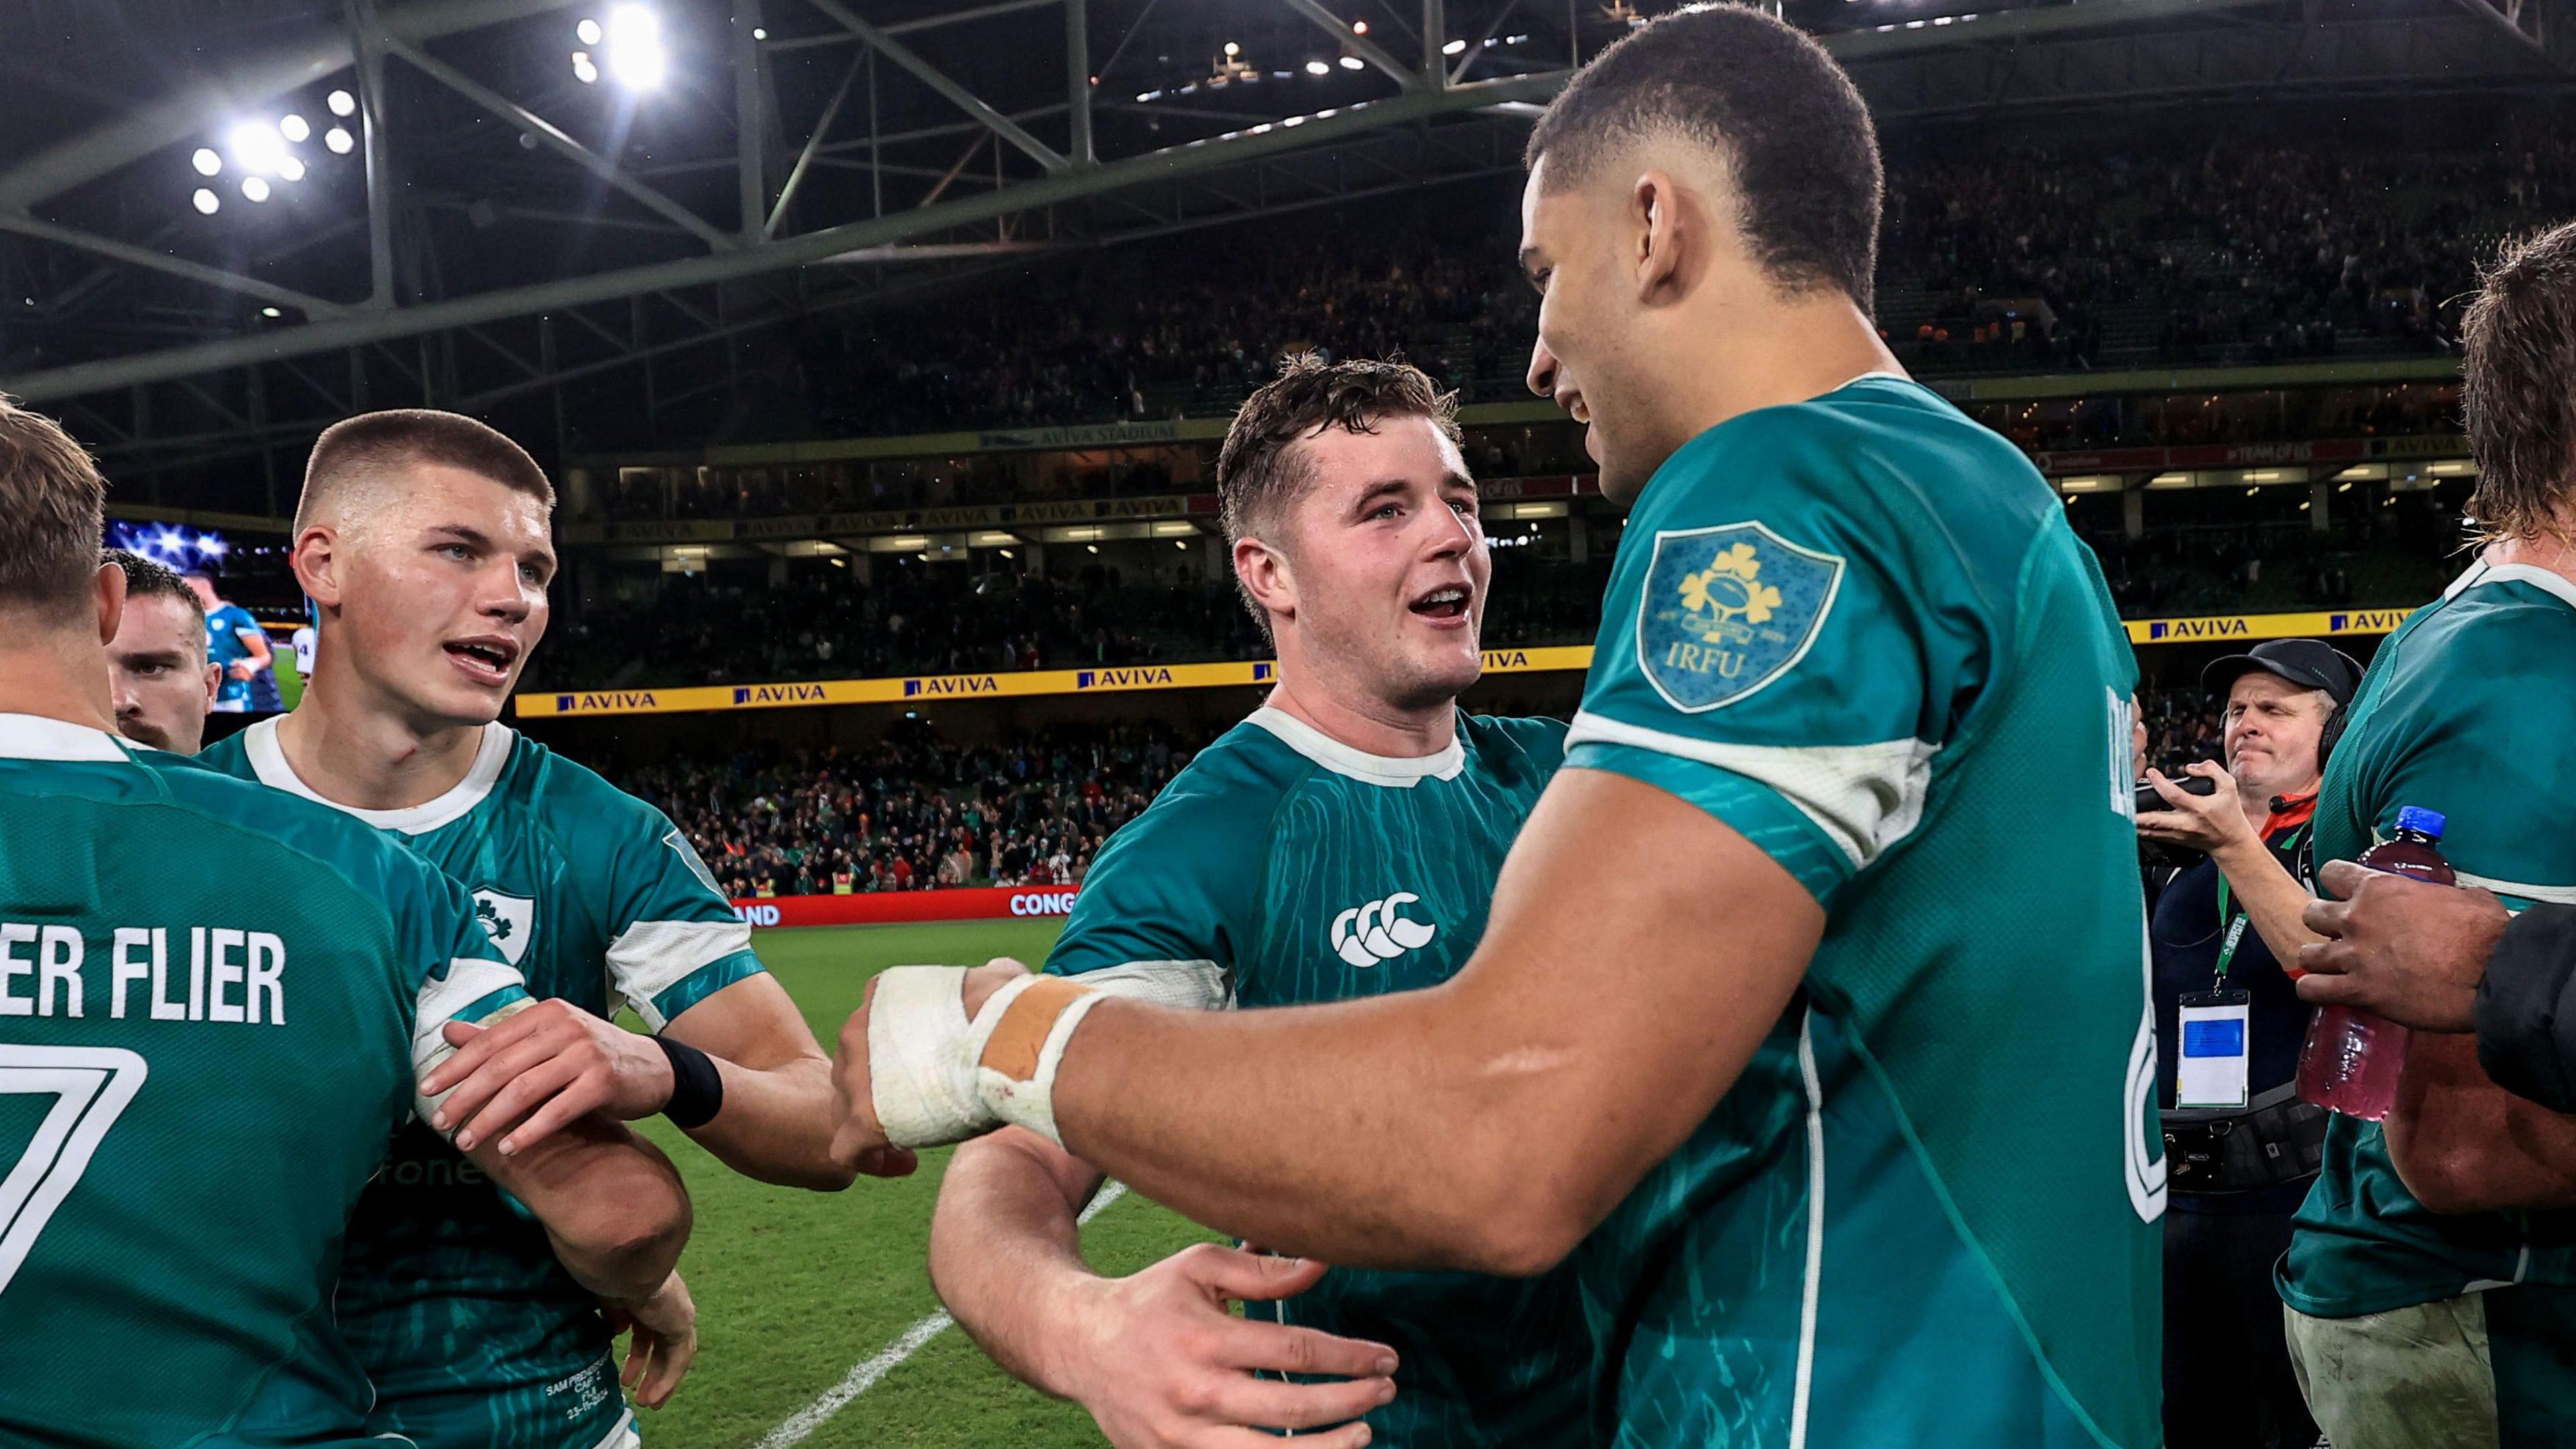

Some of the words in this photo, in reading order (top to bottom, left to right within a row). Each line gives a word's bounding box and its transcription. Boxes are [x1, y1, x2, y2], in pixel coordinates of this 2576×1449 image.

[1020, 504, 1083, 519] AVIVA
[2175, 619, 2248, 637] AVIVA
[1666, 641, 1745, 679] IRFU
[926, 676, 998, 694] AVIVA
[1100, 668, 1173, 686] AVIVA
[582, 692, 657, 709] AVIVA
[756, 684, 825, 701] AVIVA
[1010, 892, 1079, 916] CONG
[0, 922, 84, 1018] ER
[111, 927, 286, 1025] FLIER
[0, 1044, 148, 1295] 7
[546, 1379, 568, 1397] SAM
